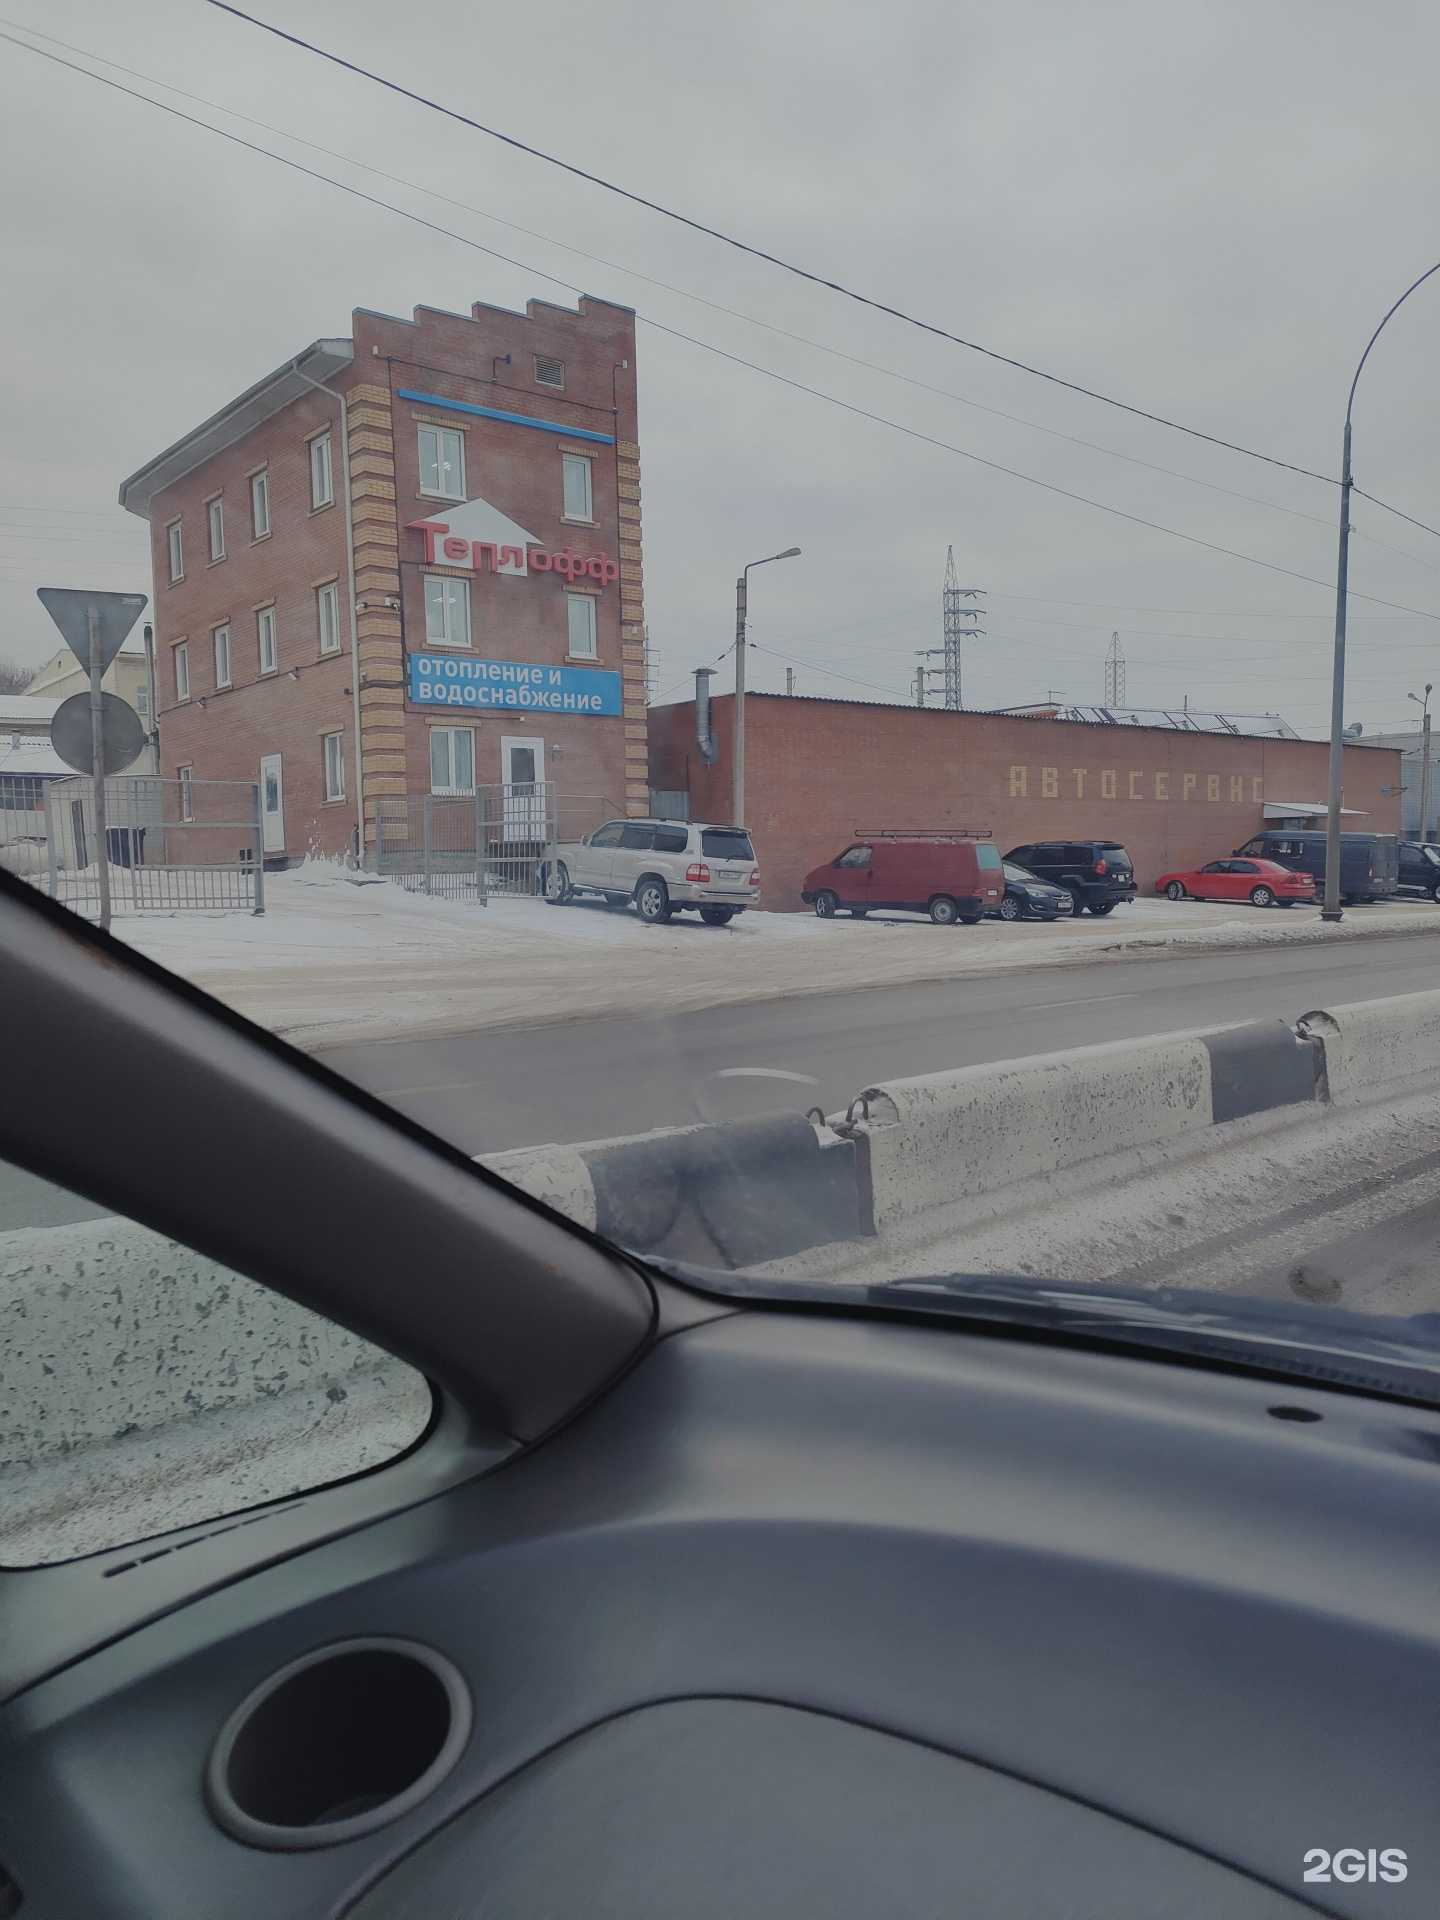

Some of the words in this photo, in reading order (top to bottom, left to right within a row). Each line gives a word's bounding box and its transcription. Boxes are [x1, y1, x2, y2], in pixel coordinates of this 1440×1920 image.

[407, 520, 620, 586] Теплофф
[418, 657, 543, 685] отопление
[549, 671, 561, 685] и
[419, 682, 603, 711] водоснабжение
